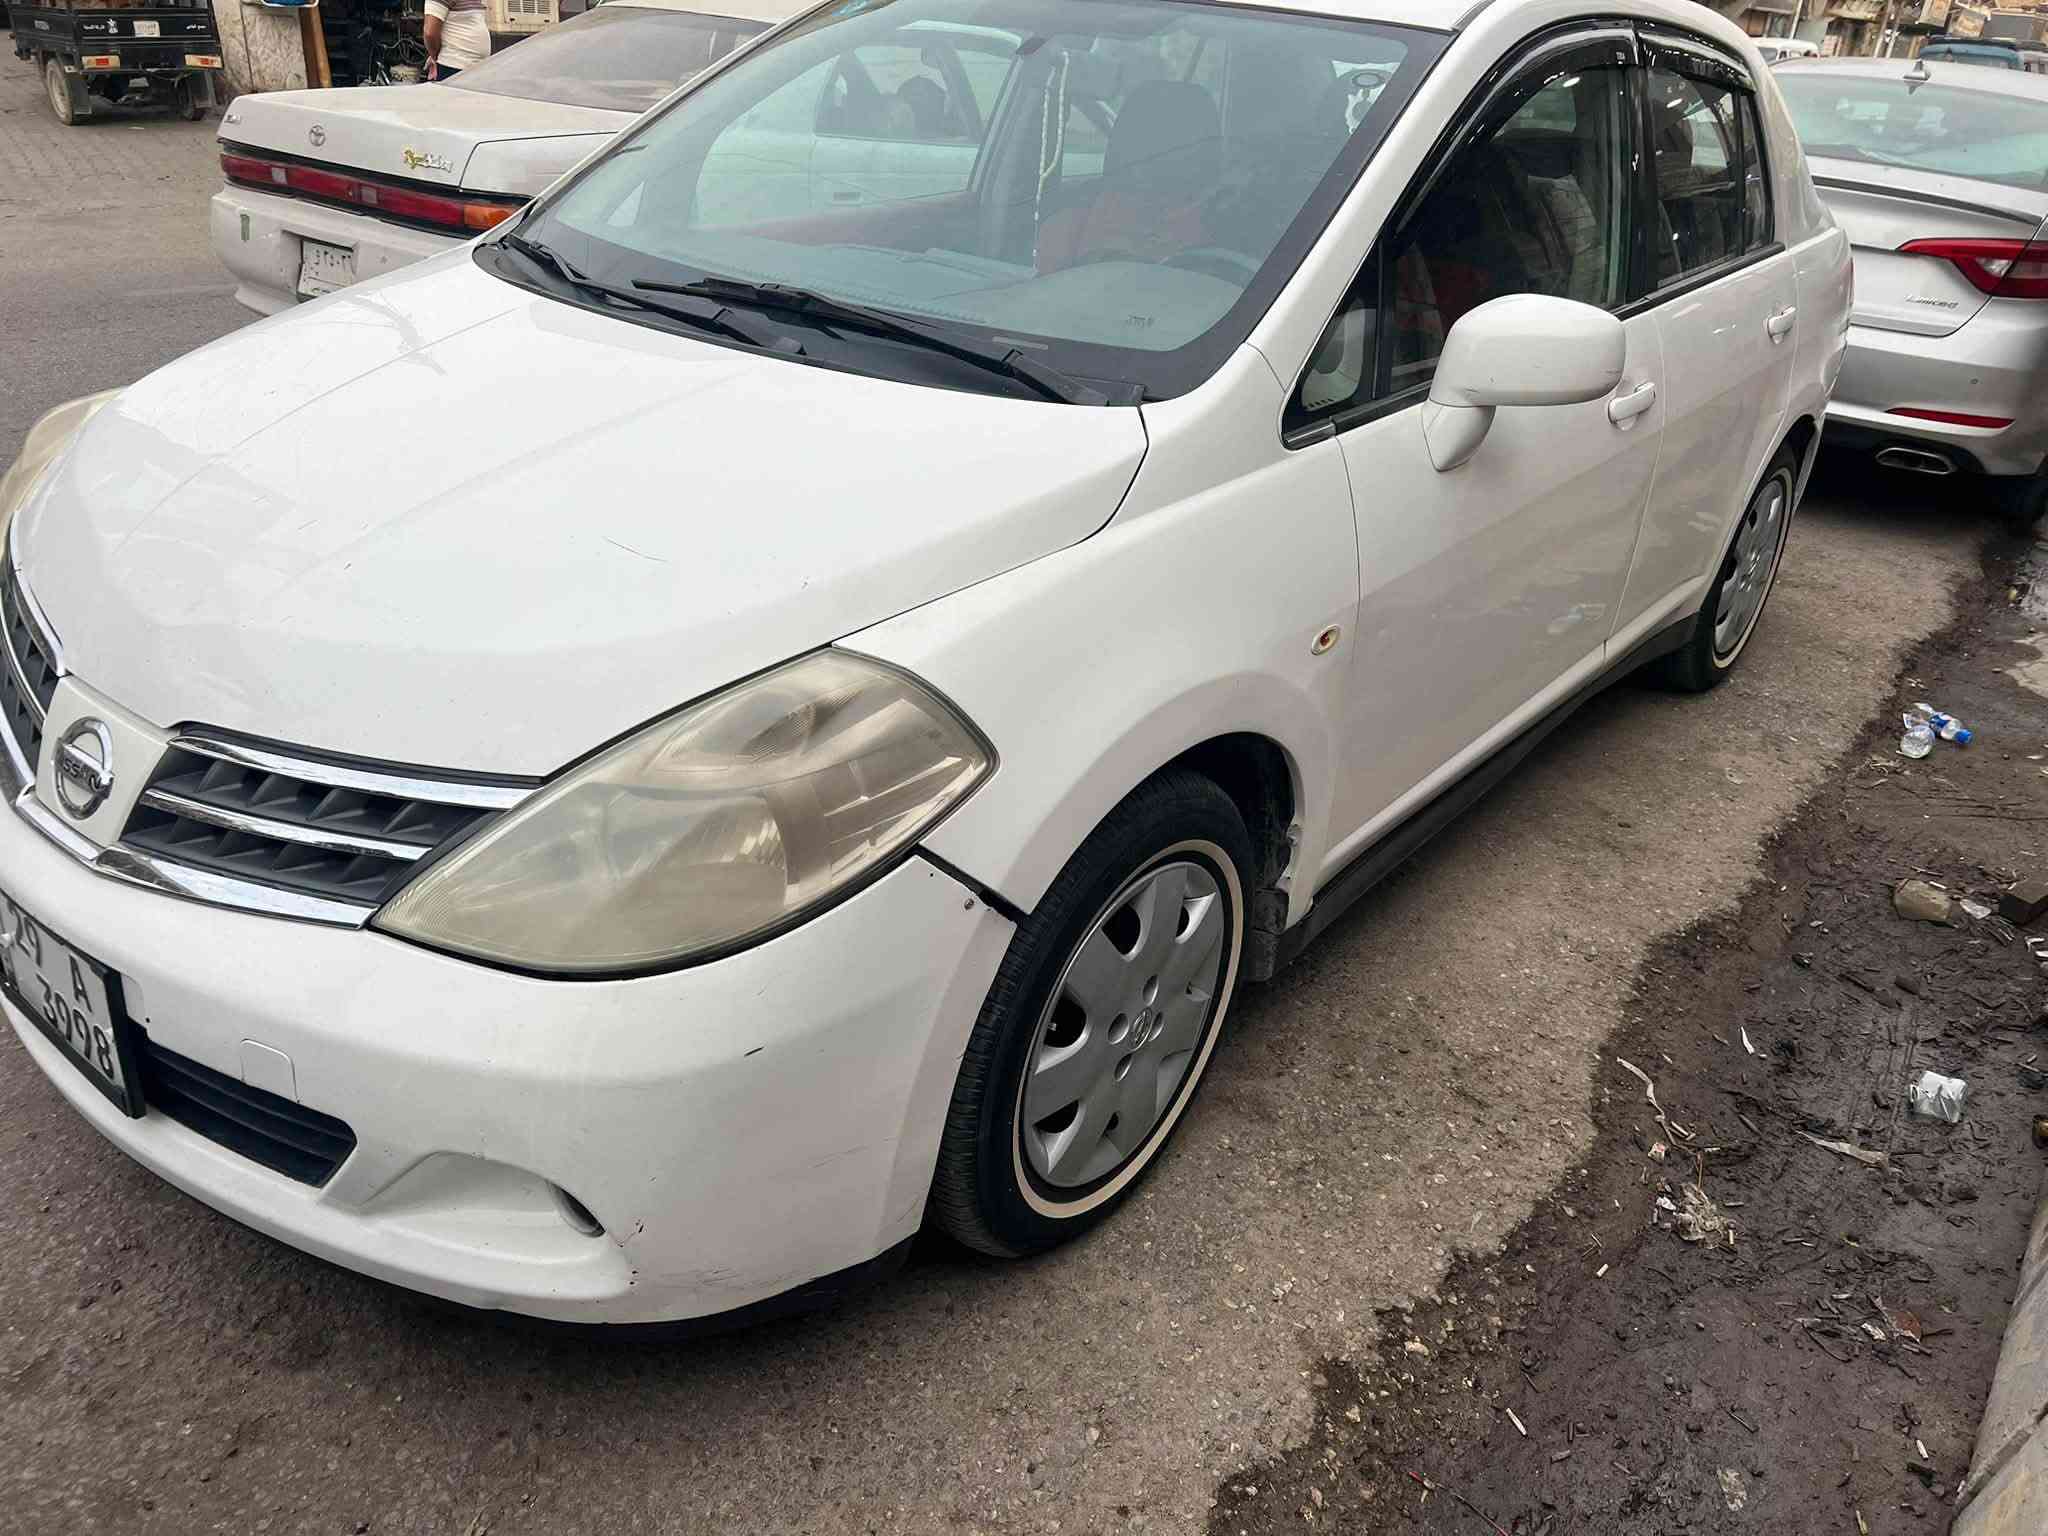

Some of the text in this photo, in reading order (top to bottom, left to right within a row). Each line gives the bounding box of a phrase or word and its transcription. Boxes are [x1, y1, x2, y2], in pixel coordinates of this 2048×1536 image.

[7, 901, 42, 968] 29
[69, 953, 92, 1013] A
[36, 973, 114, 1081] 3998
